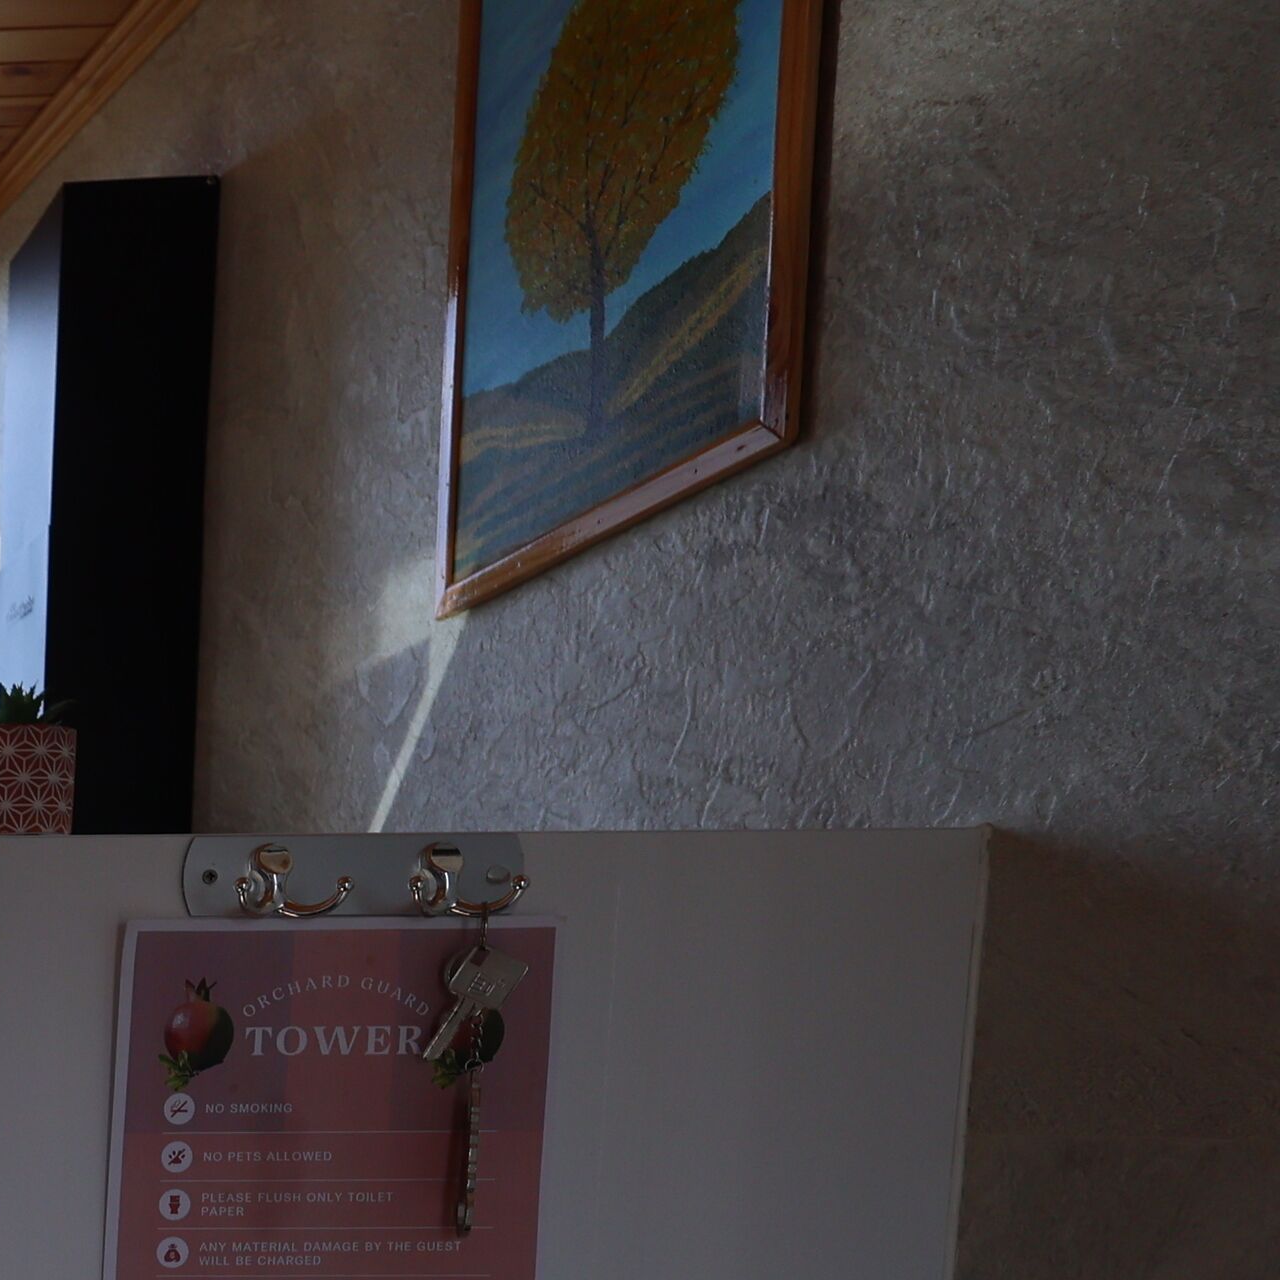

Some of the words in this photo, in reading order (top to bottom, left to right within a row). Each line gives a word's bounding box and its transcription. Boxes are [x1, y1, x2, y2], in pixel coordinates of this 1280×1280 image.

[242, 974, 350, 1017] ORCHARD
[359, 976, 430, 1017] GUARD
[244, 1025, 422, 1056] TOWER
[205, 1103, 225, 1114] NO
[229, 1103, 294, 1114] SMOKING
[202, 1151, 223, 1161] NO
[227, 1151, 262, 1161] PETS
[266, 1151, 333, 1161] ALLOWED
[201, 1192, 252, 1203] PLEASE
[257, 1191, 301, 1203] FLUSH
[306, 1191, 343, 1203] ONLY
[347, 1191, 394, 1203] TOILET
[200, 1206, 245, 1217] PAPER
[199, 1241, 226, 1252] ANY
[231, 1241, 298, 1252] MATERIAL
[303, 1241, 359, 1252] DAMAGE
[364, 1241, 381, 1252] BY
[387, 1241, 412, 1252] THE
[416, 1240, 462, 1252] GUEST
[199, 1255, 230, 1266] WILL
[235, 1255, 252, 1266] BE
[257, 1255, 322, 1266] CHARGED
